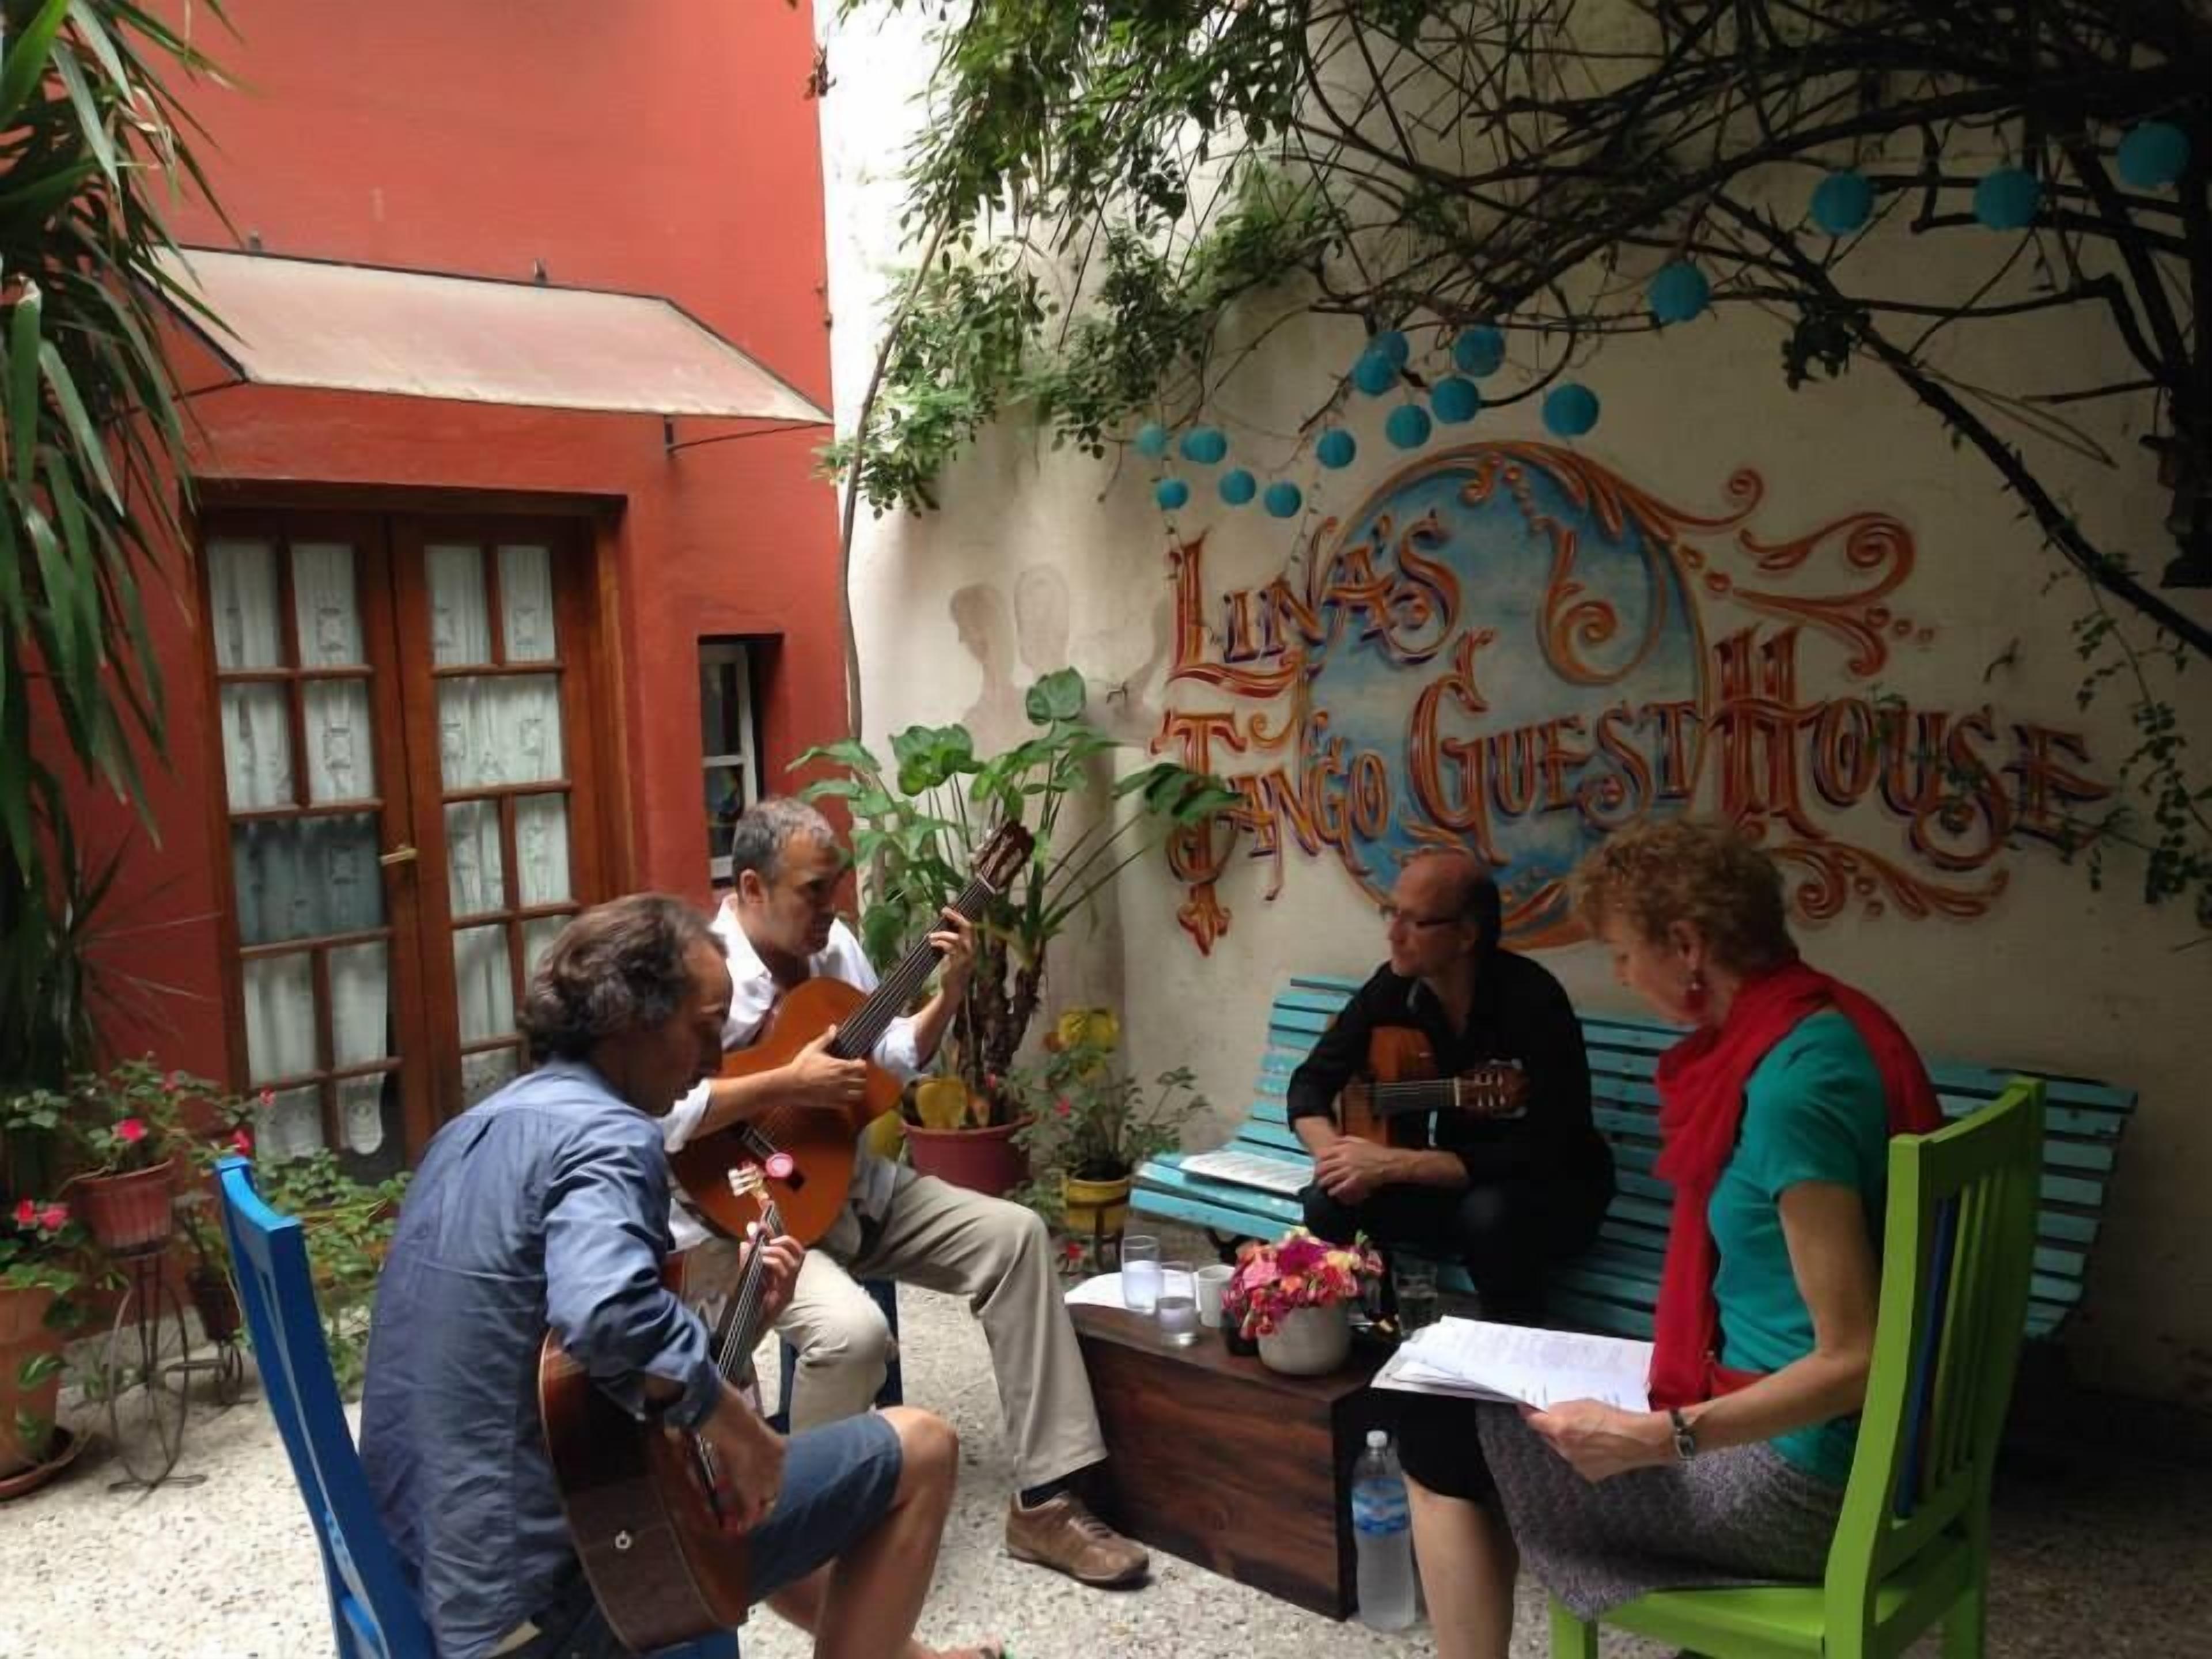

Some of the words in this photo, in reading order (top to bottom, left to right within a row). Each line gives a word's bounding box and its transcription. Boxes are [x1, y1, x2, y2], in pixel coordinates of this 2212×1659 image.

[1166, 512, 1462, 699] LINA'S
[1151, 709, 1388, 956] TANGO
[1409, 628, 1704, 865] GUEST
[1707, 624, 2114, 872] HOUSE
